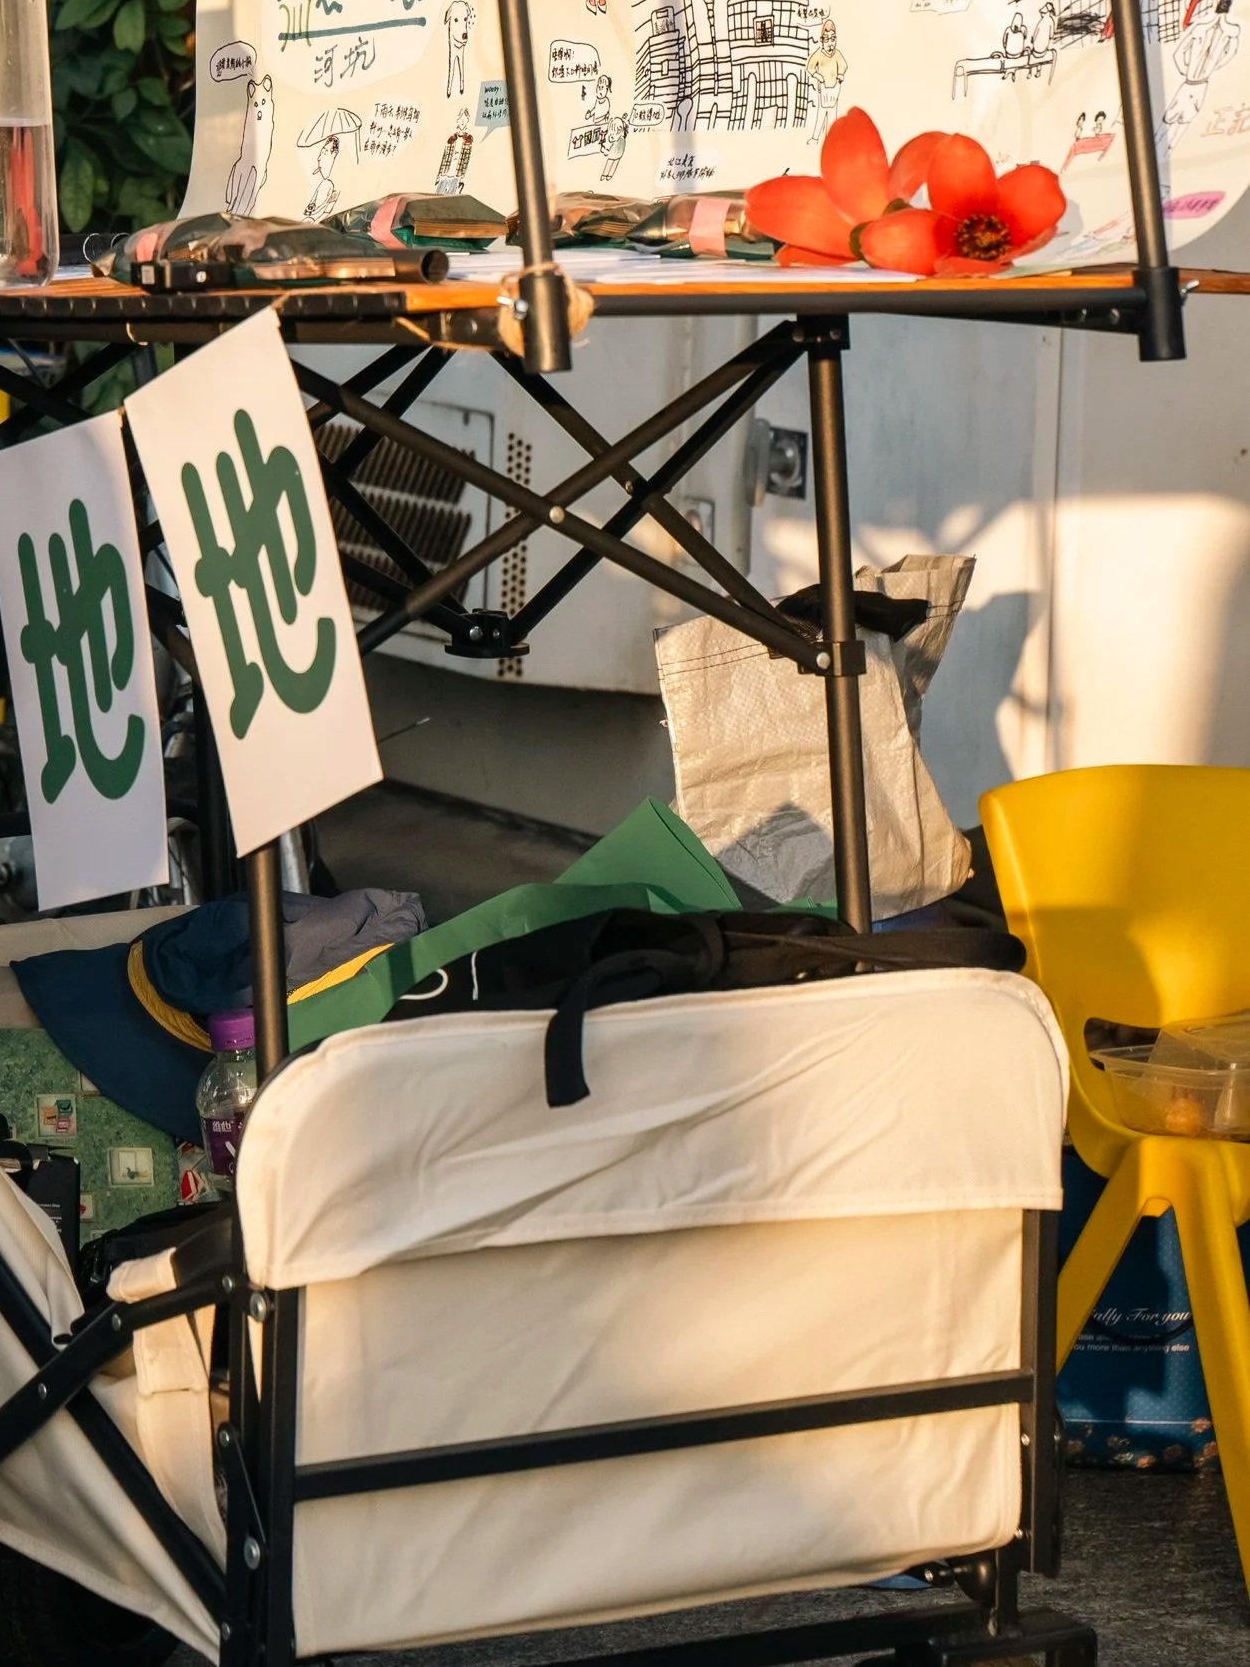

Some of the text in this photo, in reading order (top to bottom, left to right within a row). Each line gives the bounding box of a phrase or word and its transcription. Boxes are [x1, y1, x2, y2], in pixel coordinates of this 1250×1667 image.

[314, 37, 376, 88] 河坑
[1126, 1307, 1156, 1322] For
[1155, 1310, 1191, 1327] you
[1087, 1343, 1110, 1351] more
[1171, 1343, 1190, 1351] else
